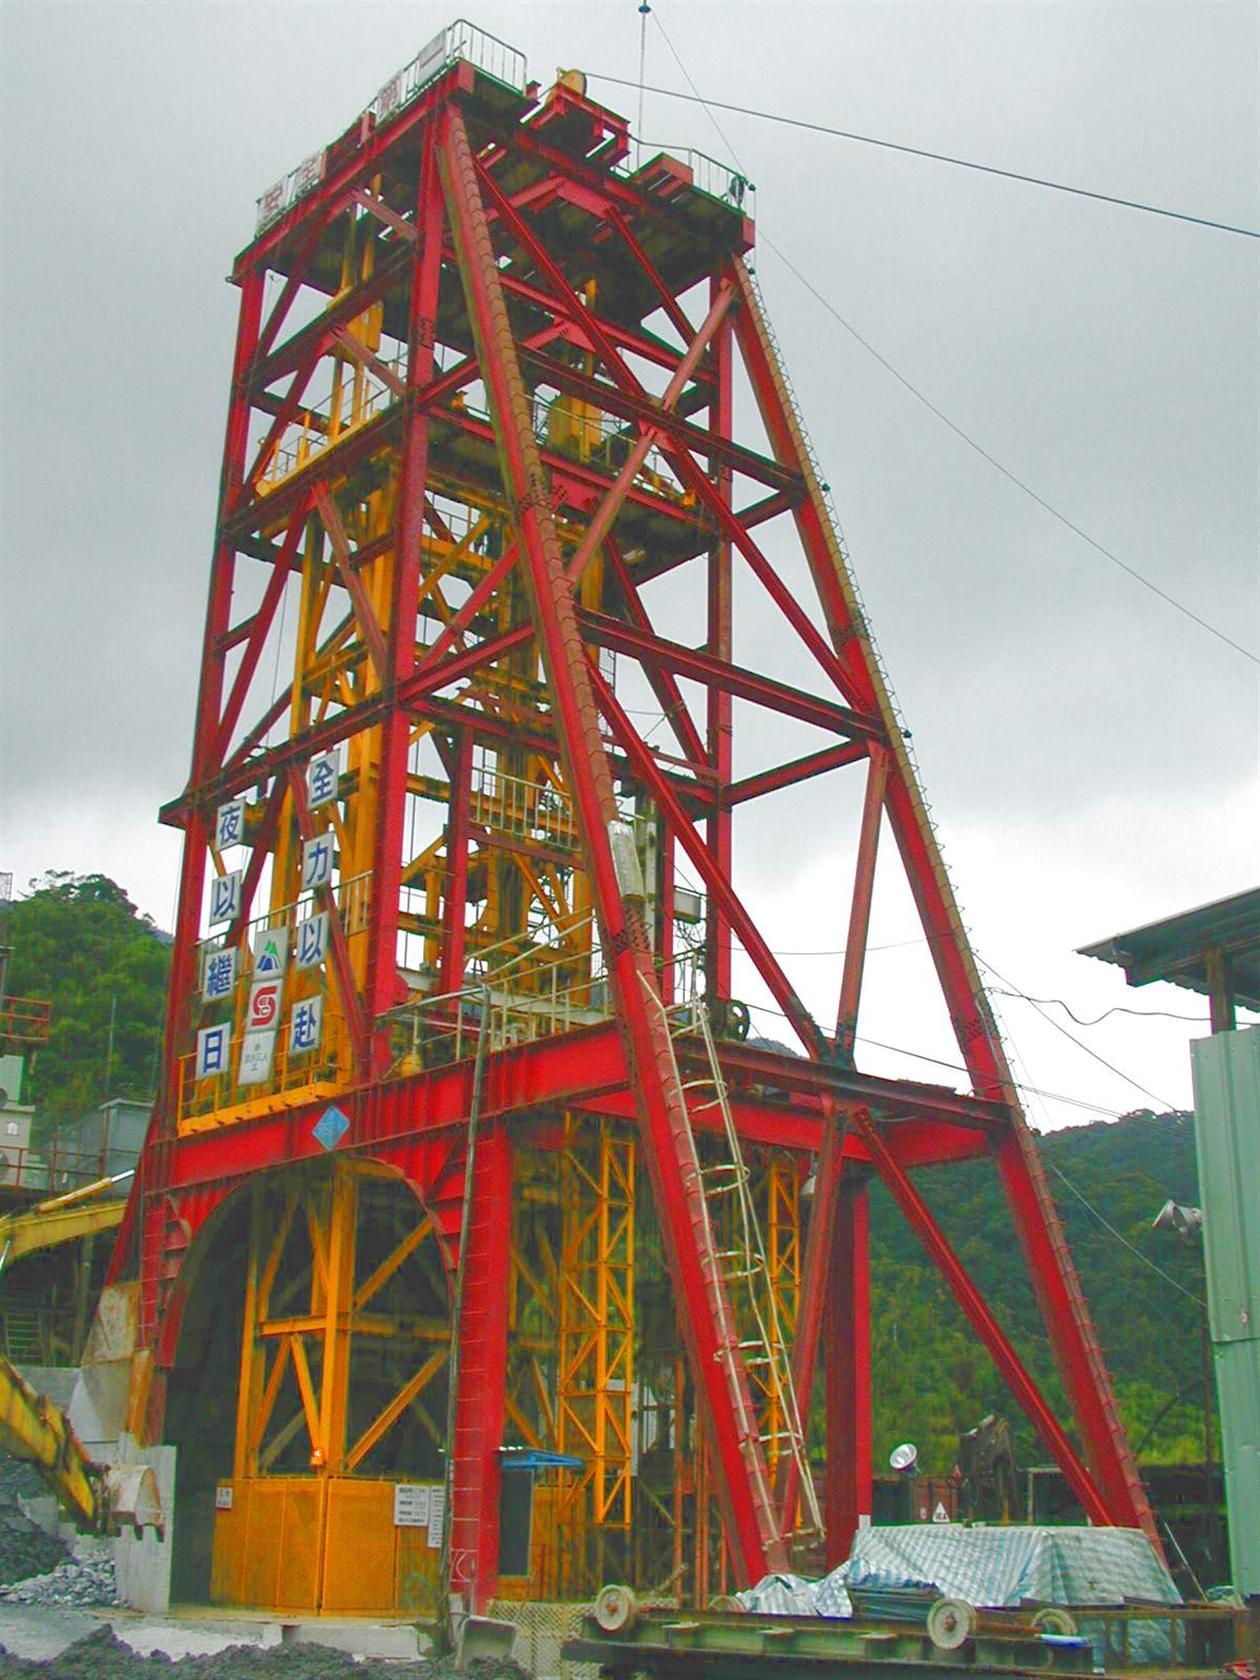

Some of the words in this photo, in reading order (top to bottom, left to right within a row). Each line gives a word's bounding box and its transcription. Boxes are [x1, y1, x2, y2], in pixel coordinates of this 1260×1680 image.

[203, 806, 241, 1073] 夜以繼日
[294, 760, 334, 1048] 全力以赴
